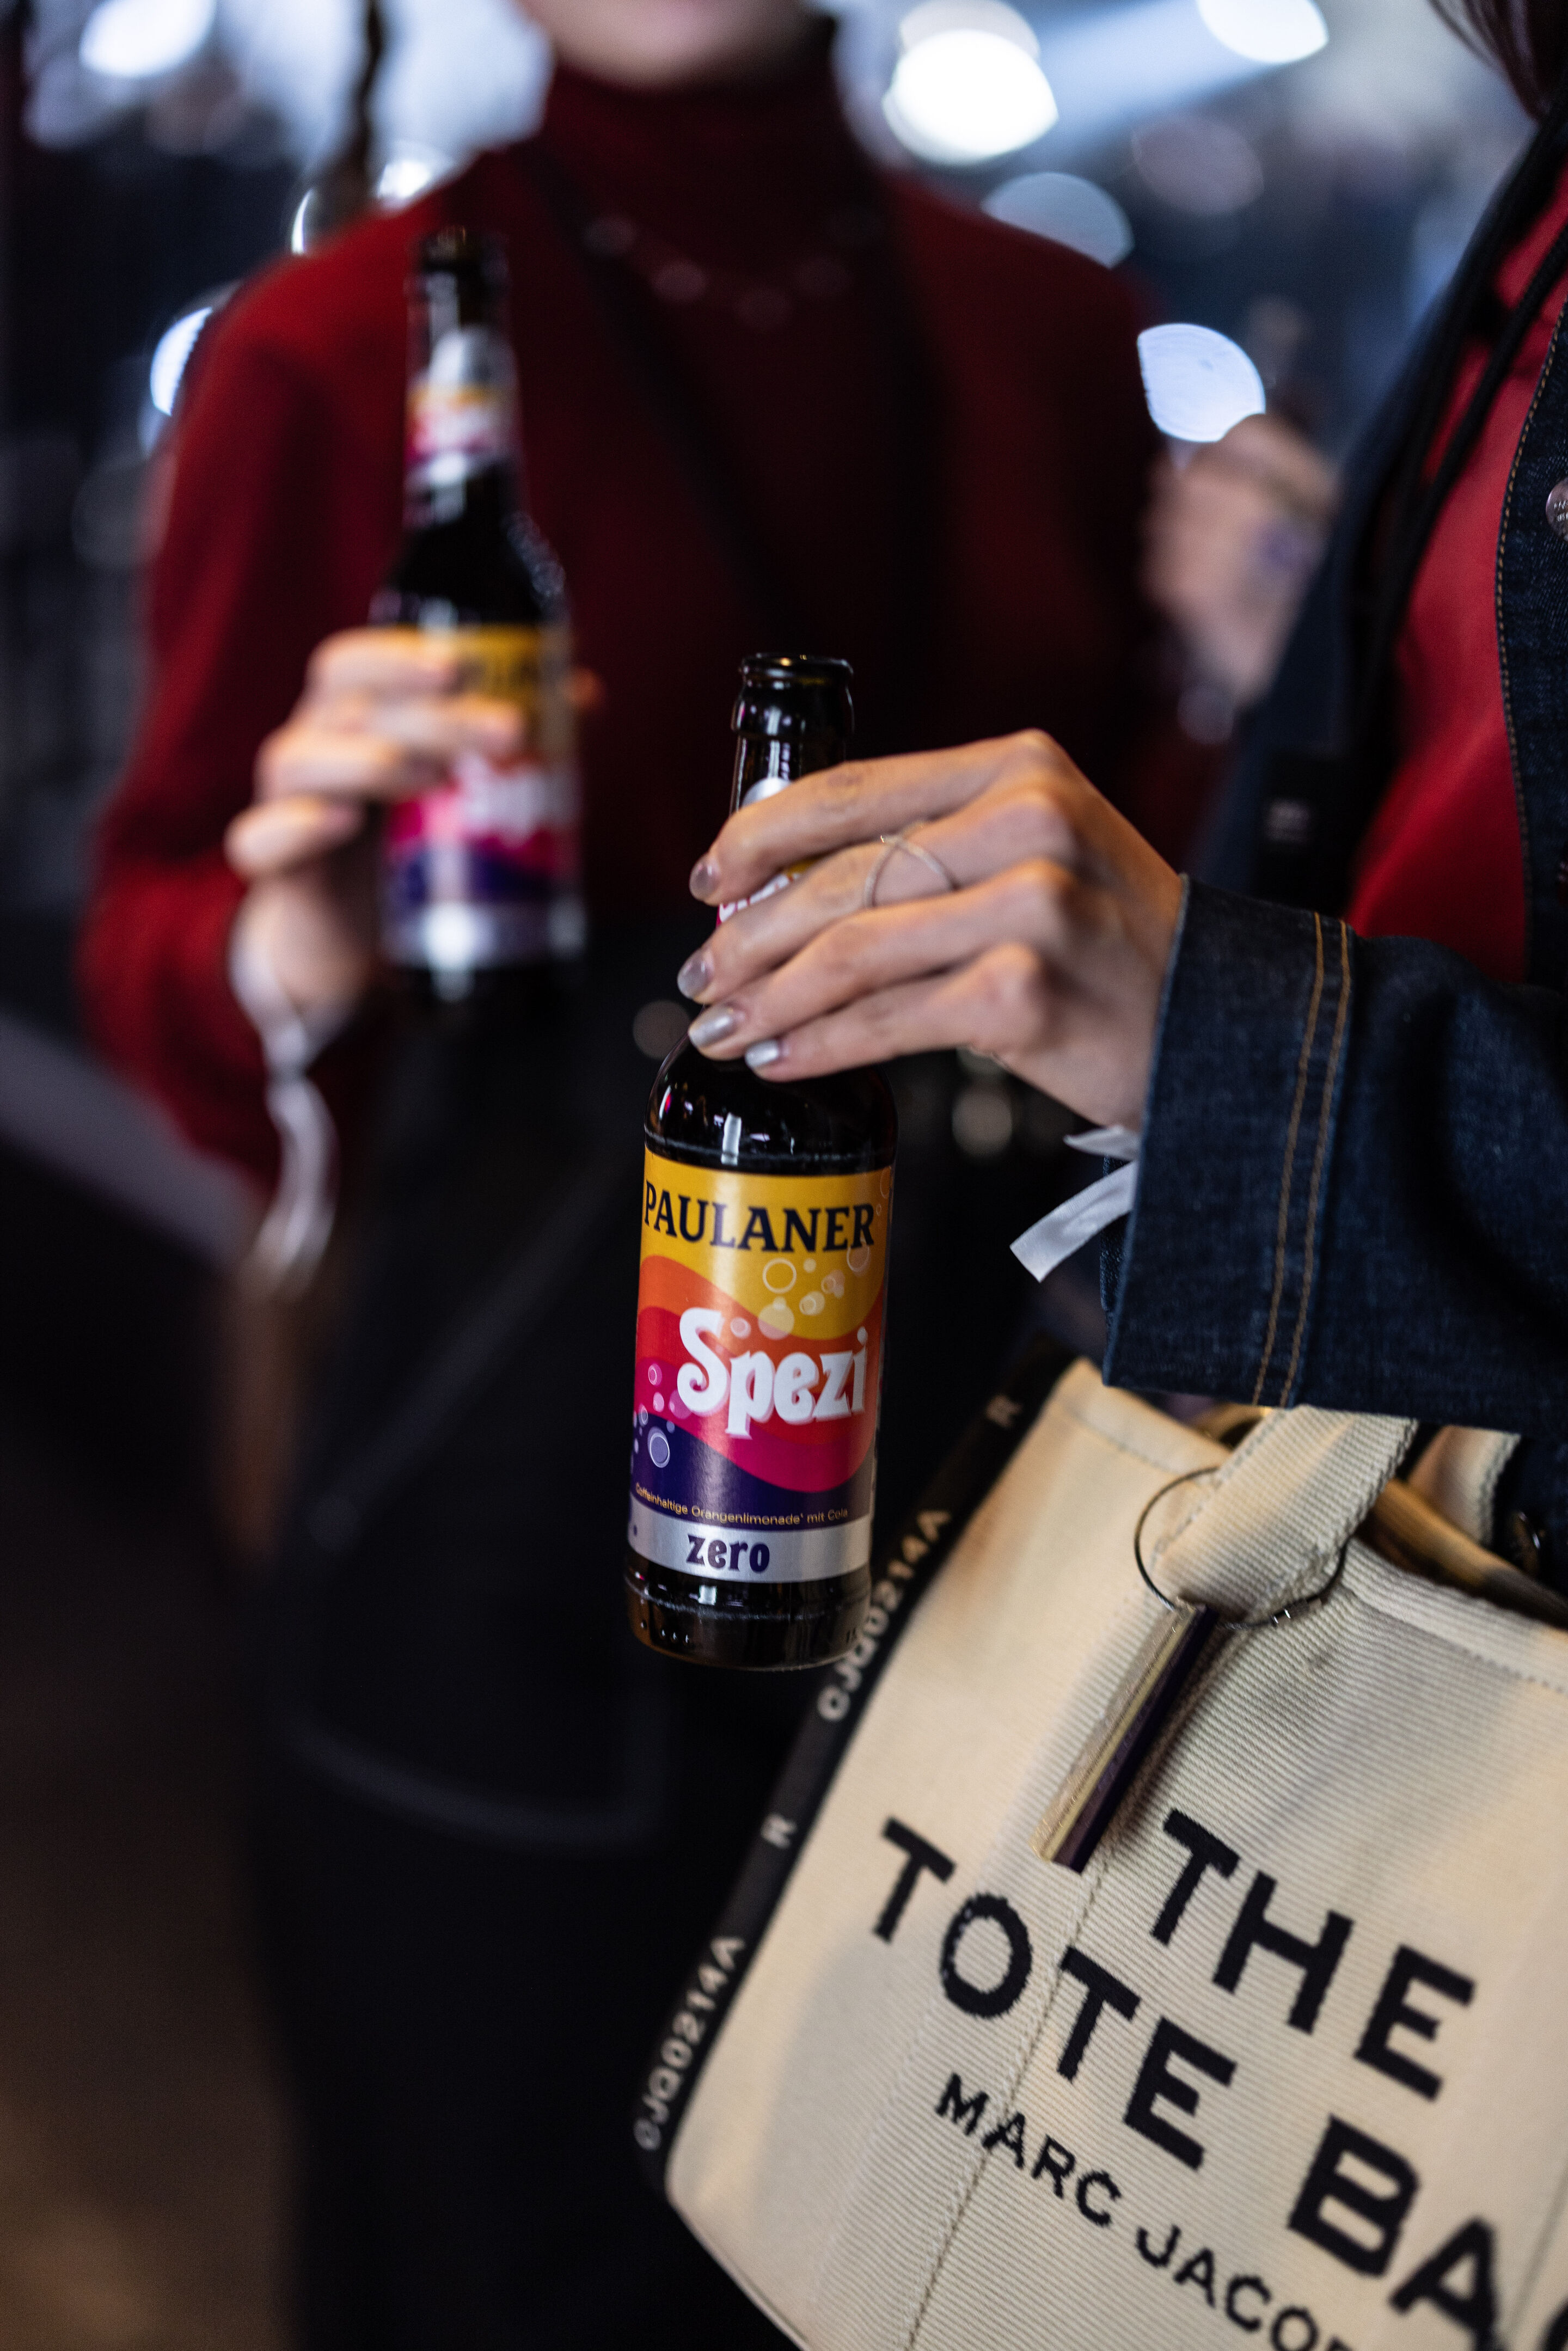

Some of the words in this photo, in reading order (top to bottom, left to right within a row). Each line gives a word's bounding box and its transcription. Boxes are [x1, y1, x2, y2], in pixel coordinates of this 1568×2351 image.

[645, 1179, 874, 1253] PAULANER
[677, 1307, 868, 1440] Spezi
[686, 1534, 769, 1572] zero
[807, 1511, 824, 1523] mit
[873, 1816, 1238, 2171] TOTE
[1149, 1808, 1475, 2102] THE
[935, 2073, 1122, 2227] MARC
[1135, 2225, 1357, 2351] JACO
